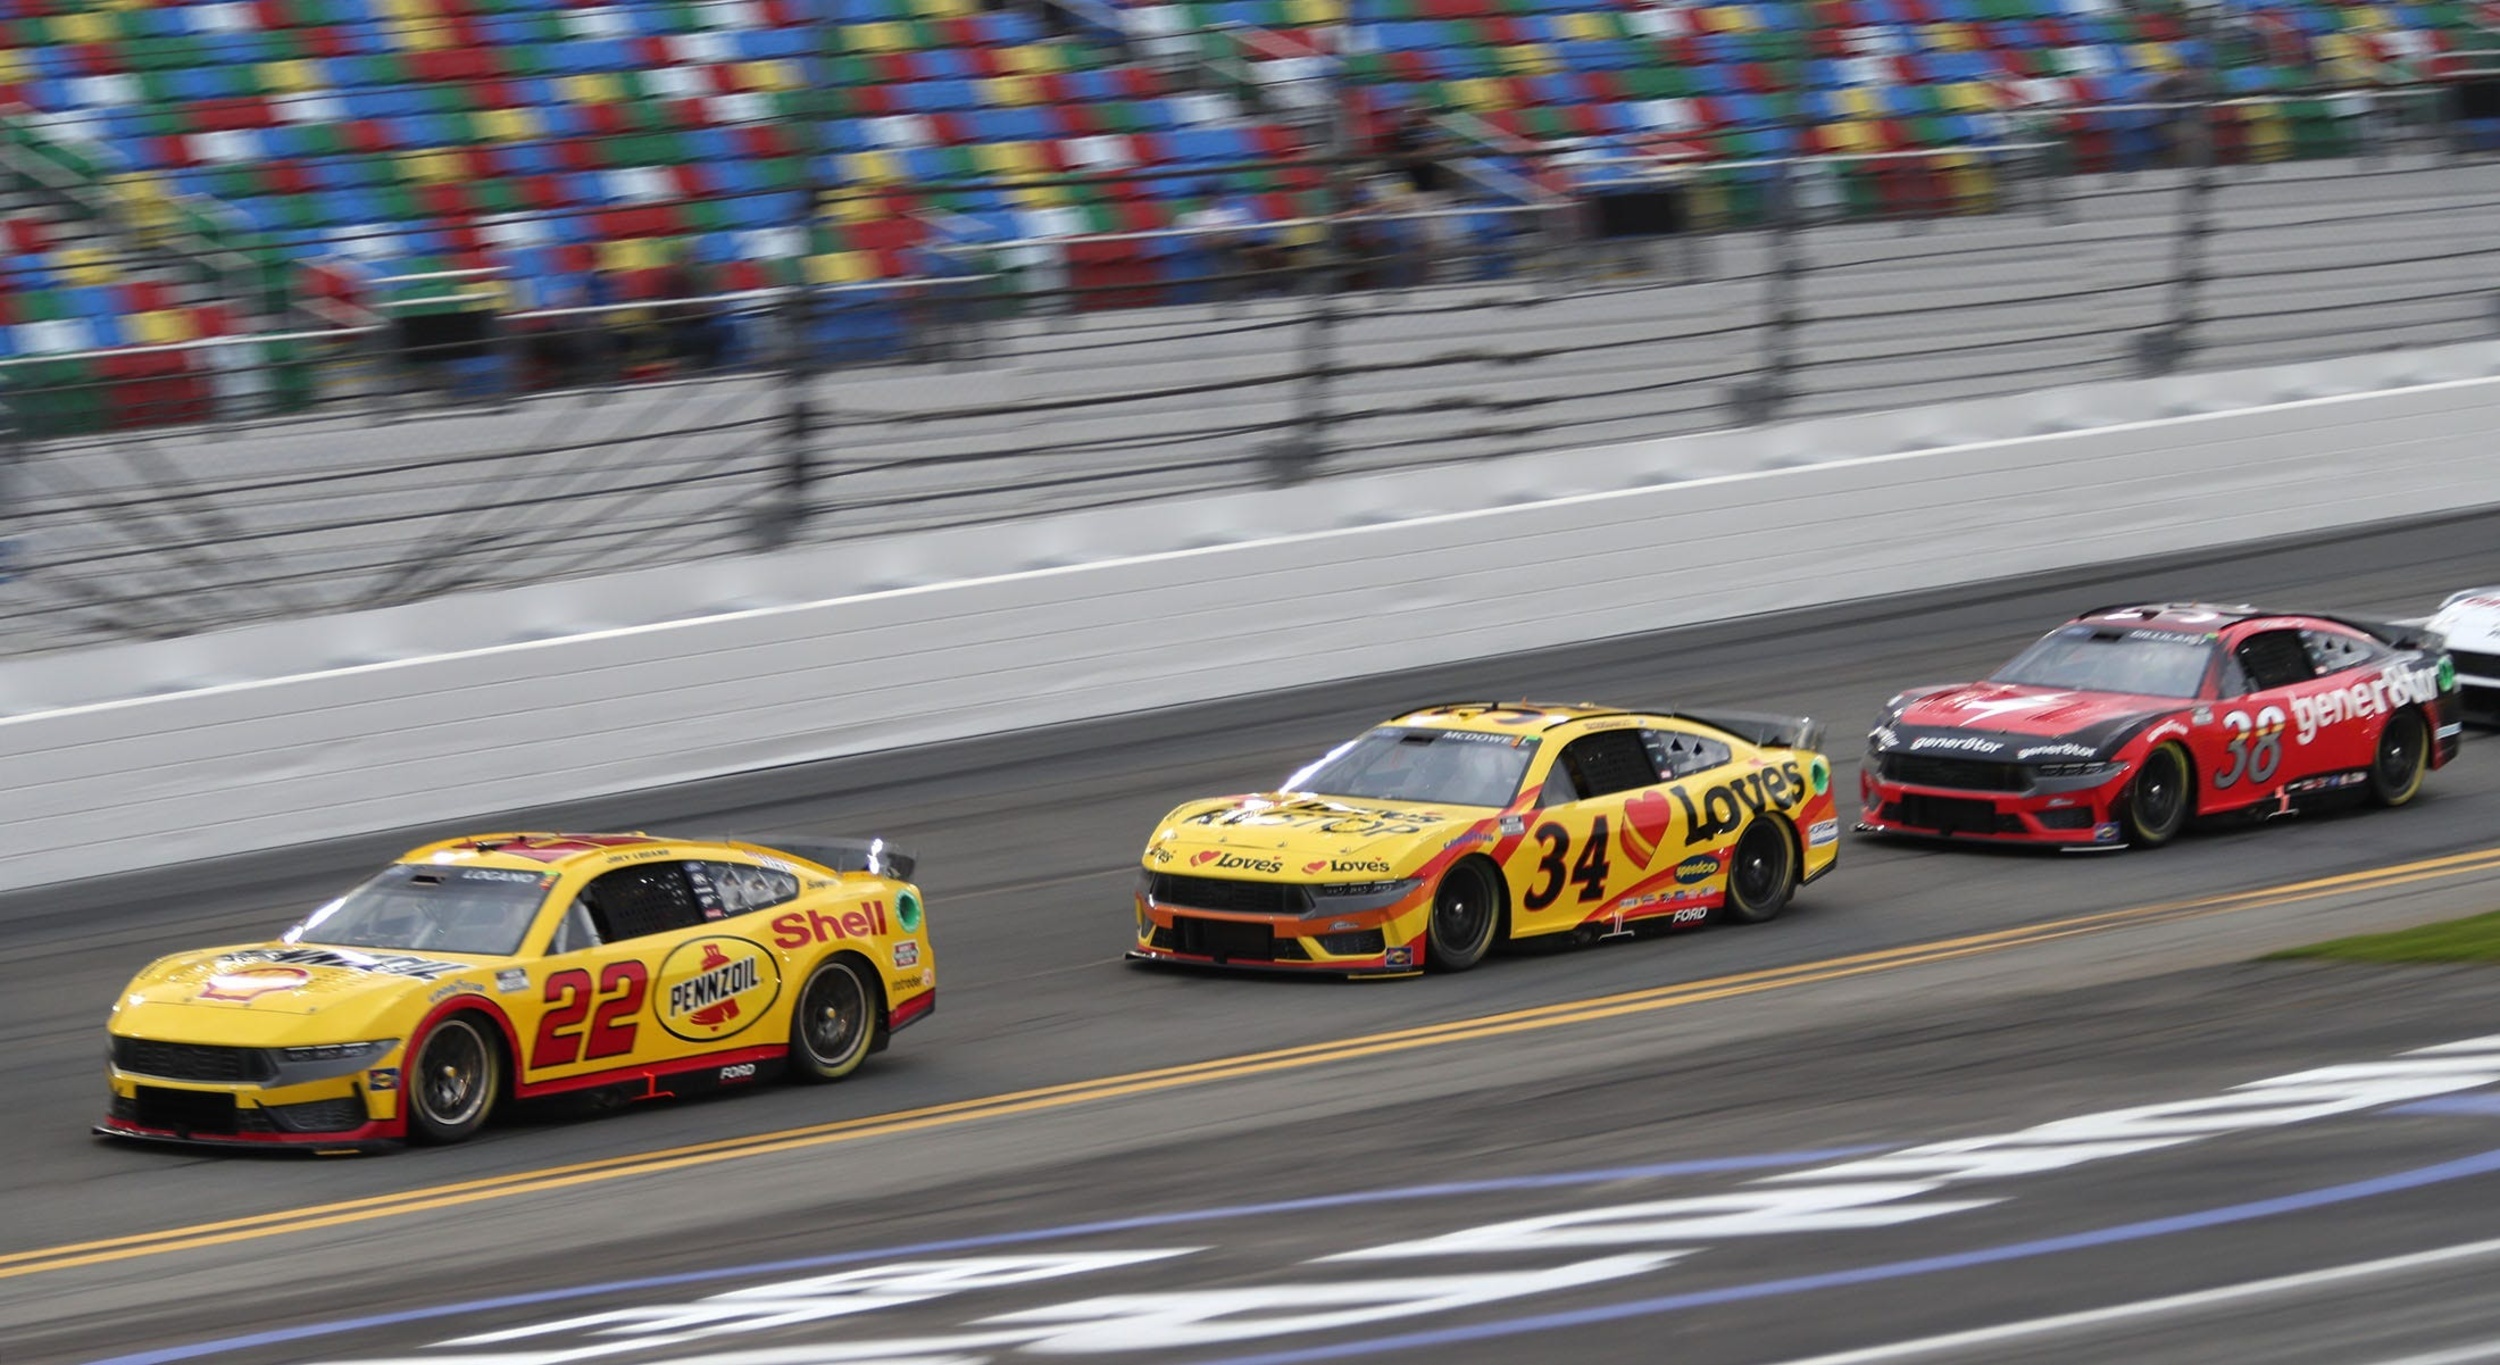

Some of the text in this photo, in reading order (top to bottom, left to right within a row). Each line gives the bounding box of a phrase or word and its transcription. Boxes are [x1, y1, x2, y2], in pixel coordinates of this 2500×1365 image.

[2213, 706, 2287, 789] 38
[1523, 814, 1610, 912] 34
[771, 901, 888, 949] Shell
[1673, 906, 1707, 923] FORD
[530, 960, 648, 1070] 22
[669, 955, 759, 1019] PENNZOIL
[720, 1063, 756, 1080] FORD
